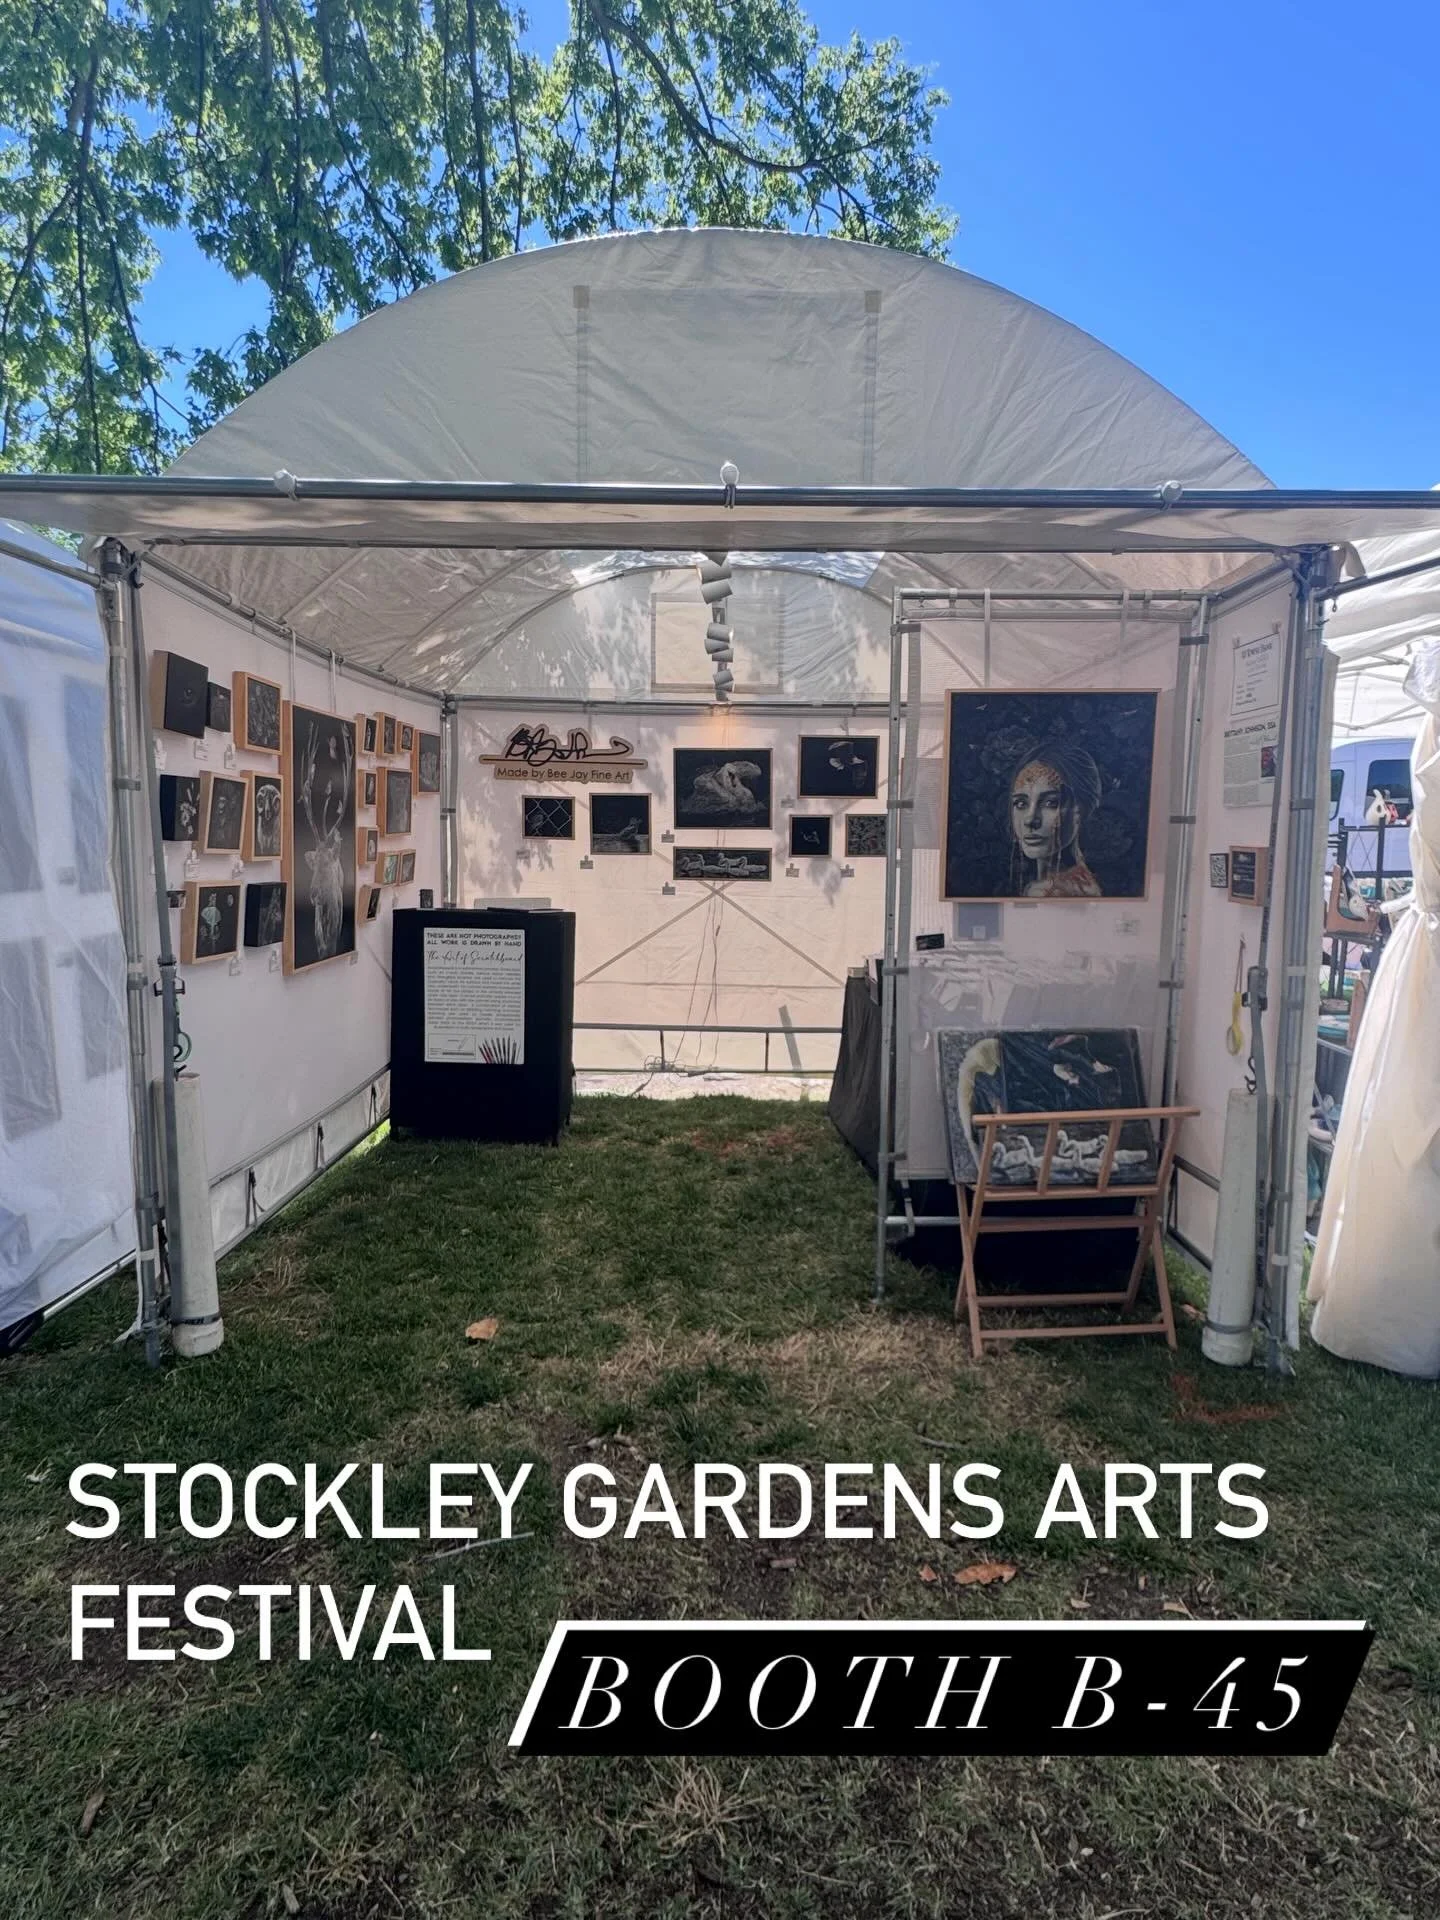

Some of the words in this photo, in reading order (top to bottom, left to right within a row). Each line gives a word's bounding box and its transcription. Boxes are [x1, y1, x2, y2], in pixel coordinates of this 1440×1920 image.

[497, 767, 529, 779] Made
[531, 768, 545, 781] by
[548, 768, 567, 779] Bee
[570, 769, 589, 782] Jay
[591, 769, 613, 780] Fine
[615, 769, 631, 780] Art
[427, 950, 440, 961] The
